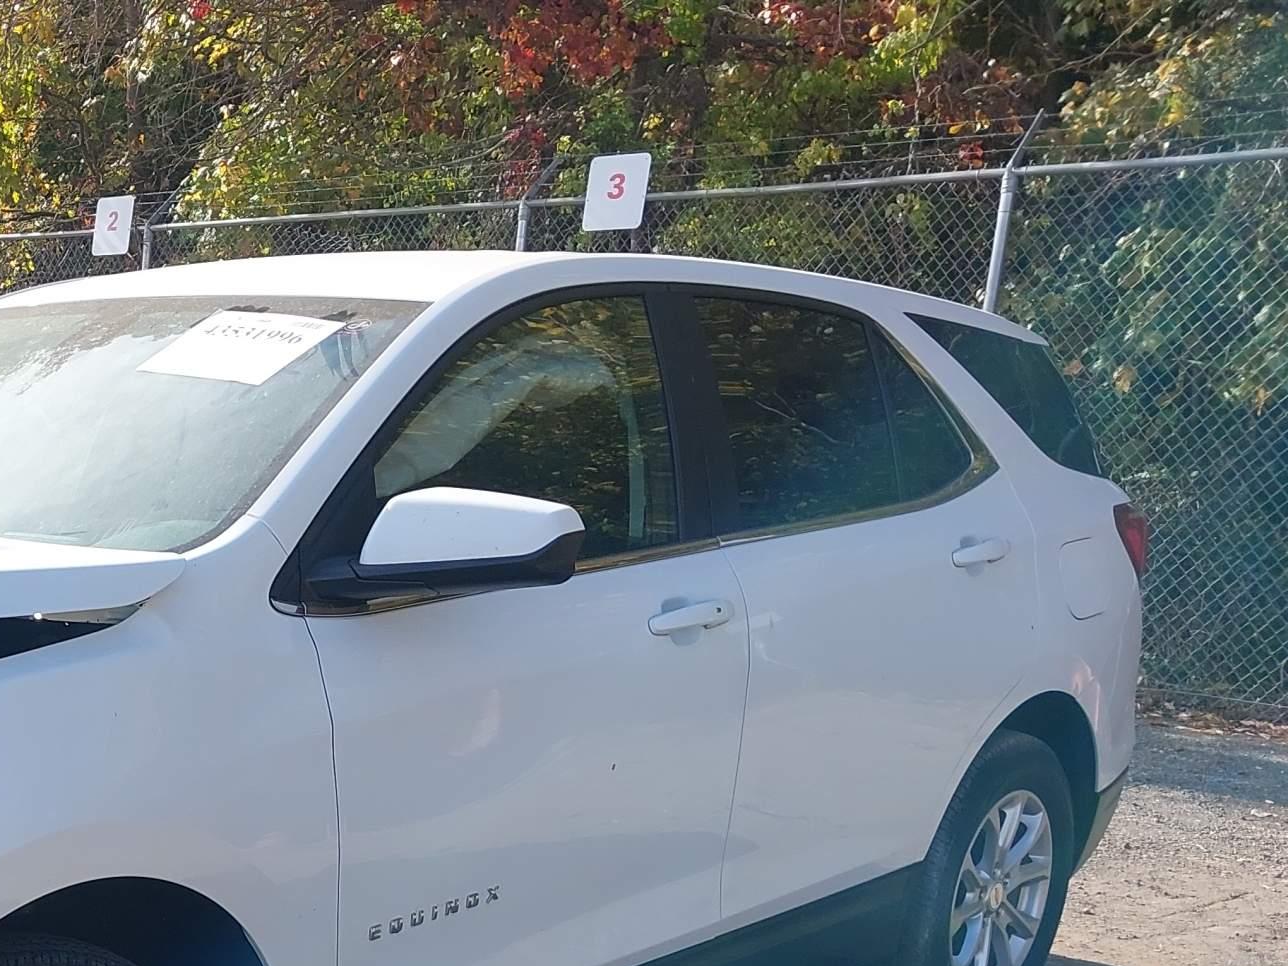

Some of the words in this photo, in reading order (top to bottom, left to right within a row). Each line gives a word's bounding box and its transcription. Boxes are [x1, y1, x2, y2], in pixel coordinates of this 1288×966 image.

[607, 173, 626, 200] 3
[107, 210, 118, 231] 2
[368, 886, 500, 942] EQUINOX
